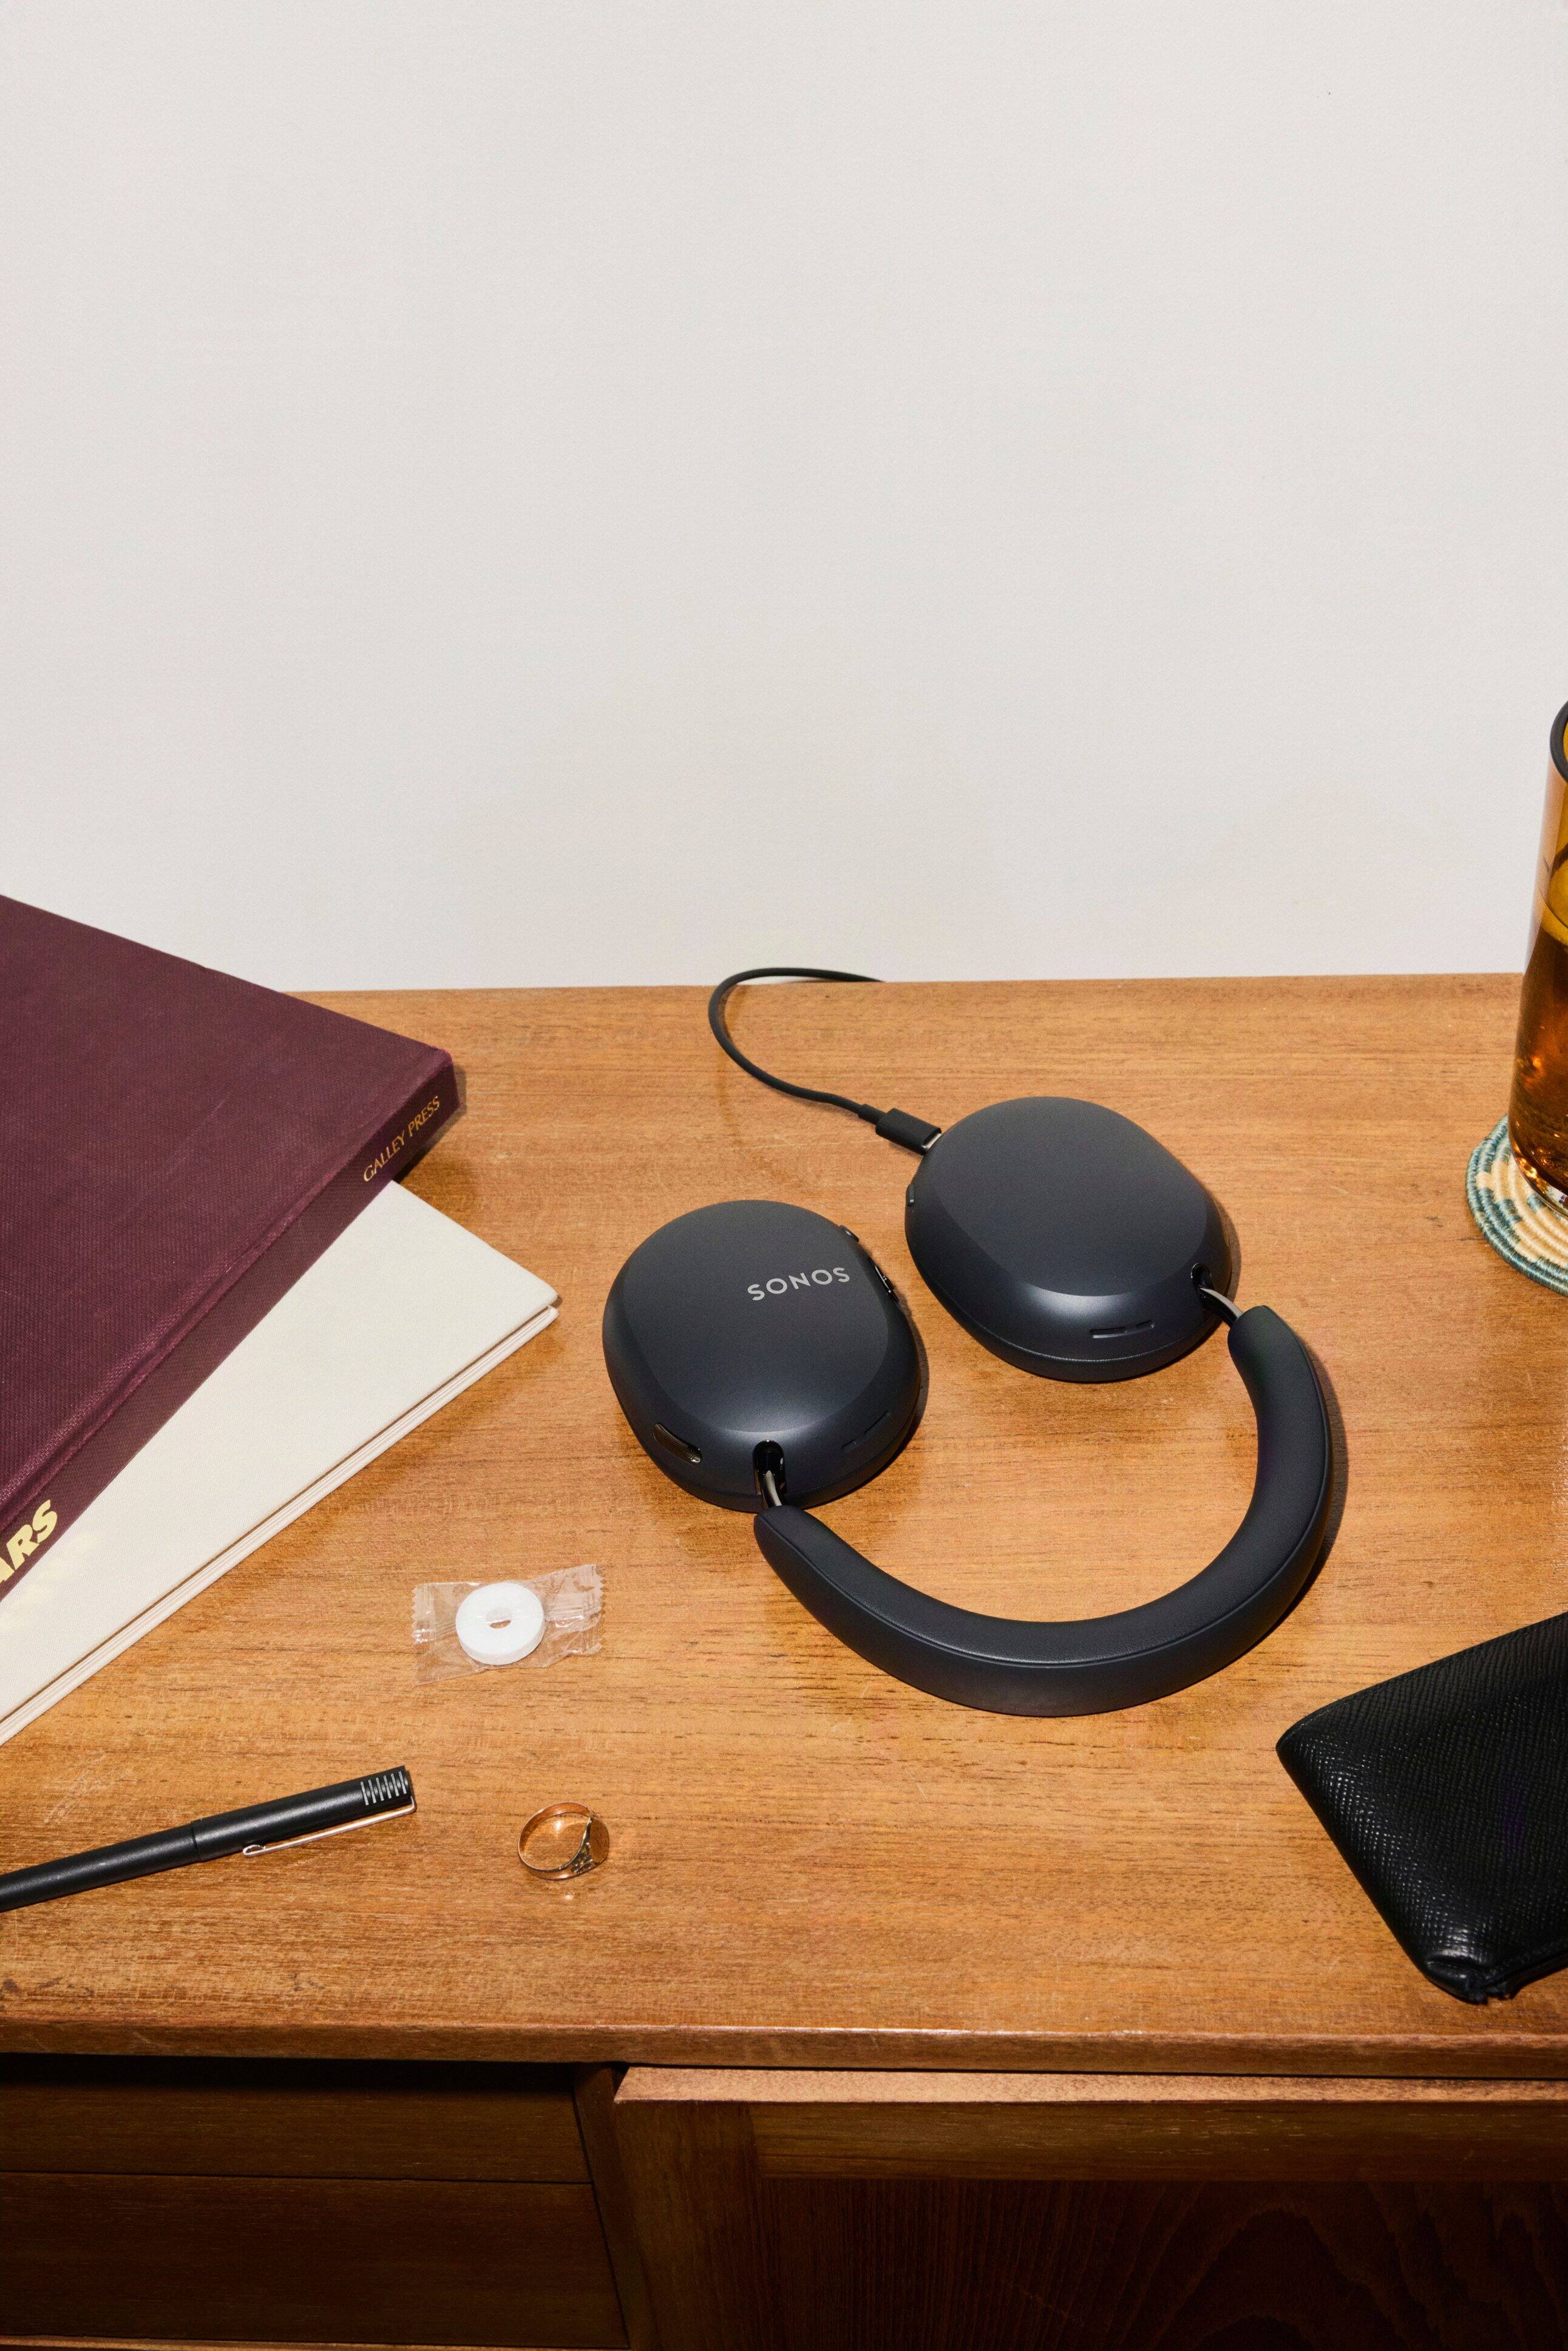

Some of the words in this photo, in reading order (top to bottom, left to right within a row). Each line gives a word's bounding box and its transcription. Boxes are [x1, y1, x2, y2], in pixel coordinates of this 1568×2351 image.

[364, 1130, 405, 1182] GALLEY
[408, 1095, 441, 1137] PRESS
[747, 1267, 850, 1300] SONOS
